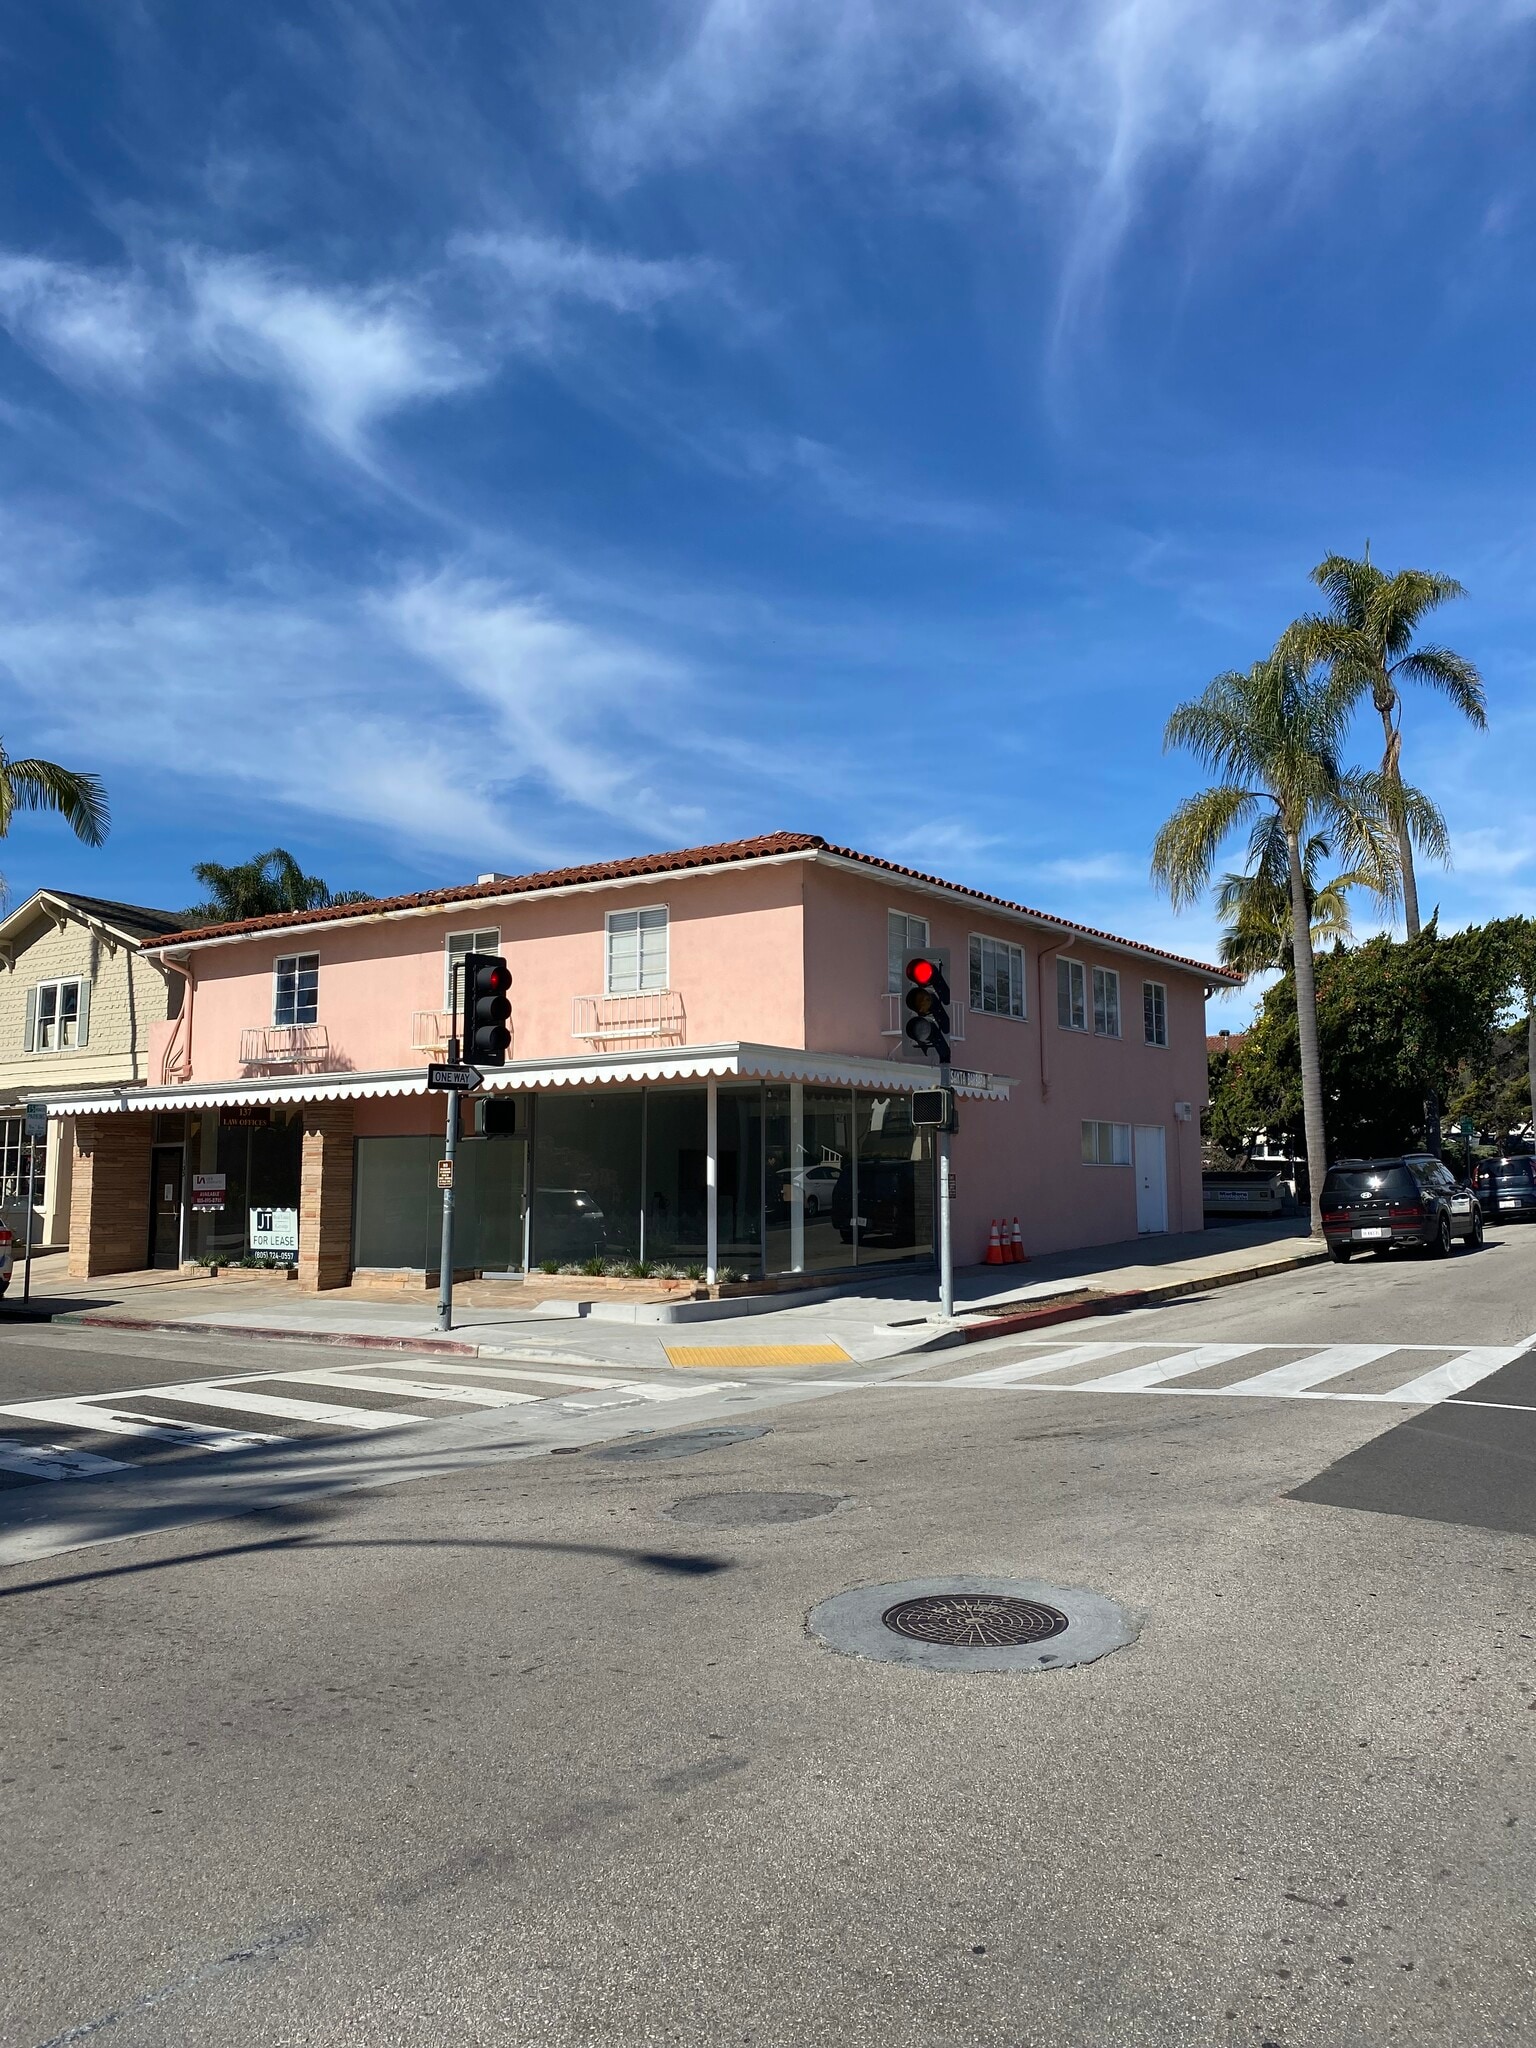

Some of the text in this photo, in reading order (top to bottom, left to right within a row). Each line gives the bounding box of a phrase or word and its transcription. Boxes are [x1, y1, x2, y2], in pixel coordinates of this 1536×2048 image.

[435, 1071, 470, 1083] ONE WAY
[950, 1070, 966, 1085] SANTA
[239, 1108, 252, 1116] 137
[223, 1118, 238, 1126] LAW
[257, 1213, 272, 1230] JT
[253, 1235, 295, 1246] FOR LEASE
[254, 1251, 268, 1260] (805)
